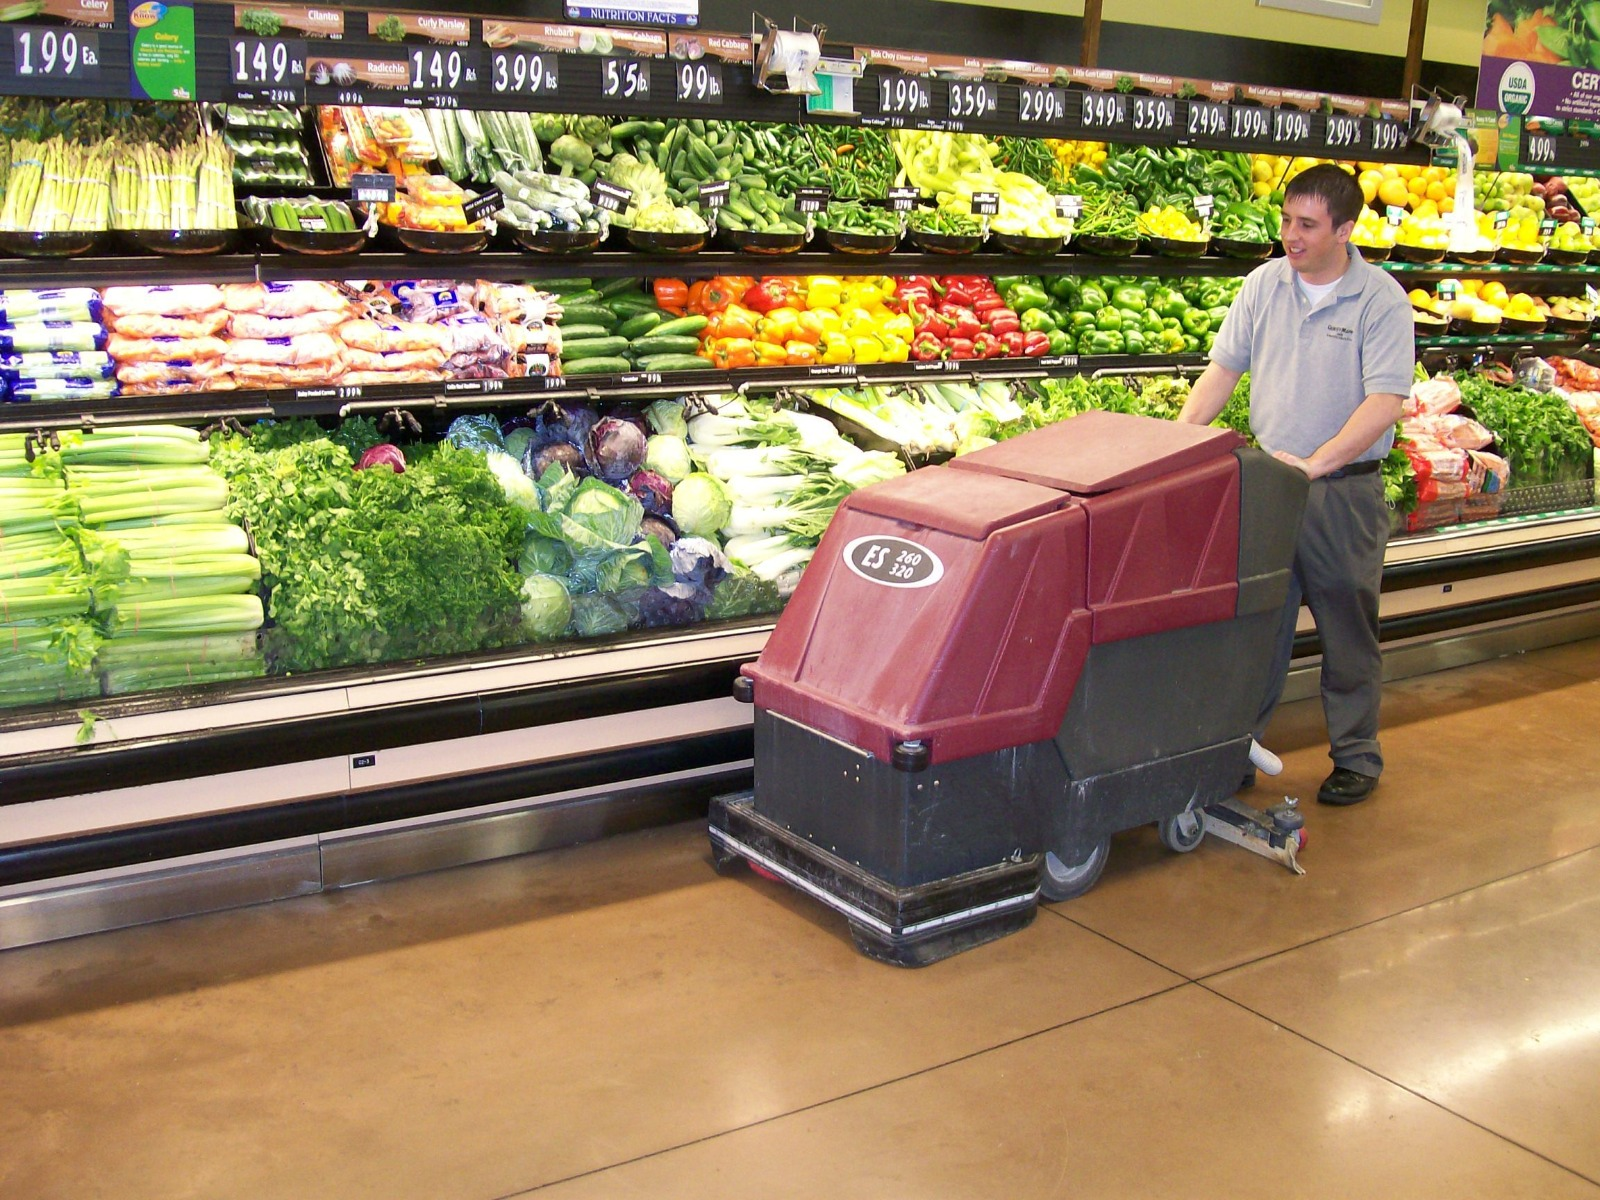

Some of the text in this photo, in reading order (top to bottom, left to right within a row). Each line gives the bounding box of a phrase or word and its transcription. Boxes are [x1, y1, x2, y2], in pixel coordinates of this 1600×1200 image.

[80, 0, 109, 11] Celery
[308, 10, 339, 21] Cilantro
[590, 8, 677, 24] NUTRITION FACTS
[418, 17, 465, 30] Curly Parsley
[544, 26, 574, 37] Rhubarb
[20, 31, 98, 75] 1.99 Ea.
[708, 38, 749, 50] Red Cabbage
[870, 50, 881, 58] Bok
[881, 50, 896, 61] Choy
[235, 41, 287, 83] 1.49
[367, 62, 405, 73] Radicchio
[412, 50, 461, 89] 1.49
[495, 54, 543, 92] 3.99
[679, 64, 721, 99] .99 lb.
[1509, 77, 1527, 90] USDA
[882, 79, 929, 112] 1.99 lb.
[951, 84, 986, 117] 3.59
[1021, 90, 1055, 122] 2.99
[1504, 93, 1529, 105] ORGANIC
[1083, 95, 1116, 127] 3.49
[1135, 100, 1166, 130] 3.59
[1190, 105, 1219, 135] 2.49
[1233, 109, 1261, 138] 1.99
[1275, 113, 1302, 142] 1.99
[1327, 118, 1353, 146] 2.99
[1373, 123, 1398, 150] 1.99
[861, 545, 891, 569] ES
[896, 550, 922, 566] 260
[888, 563, 914, 579] 320
